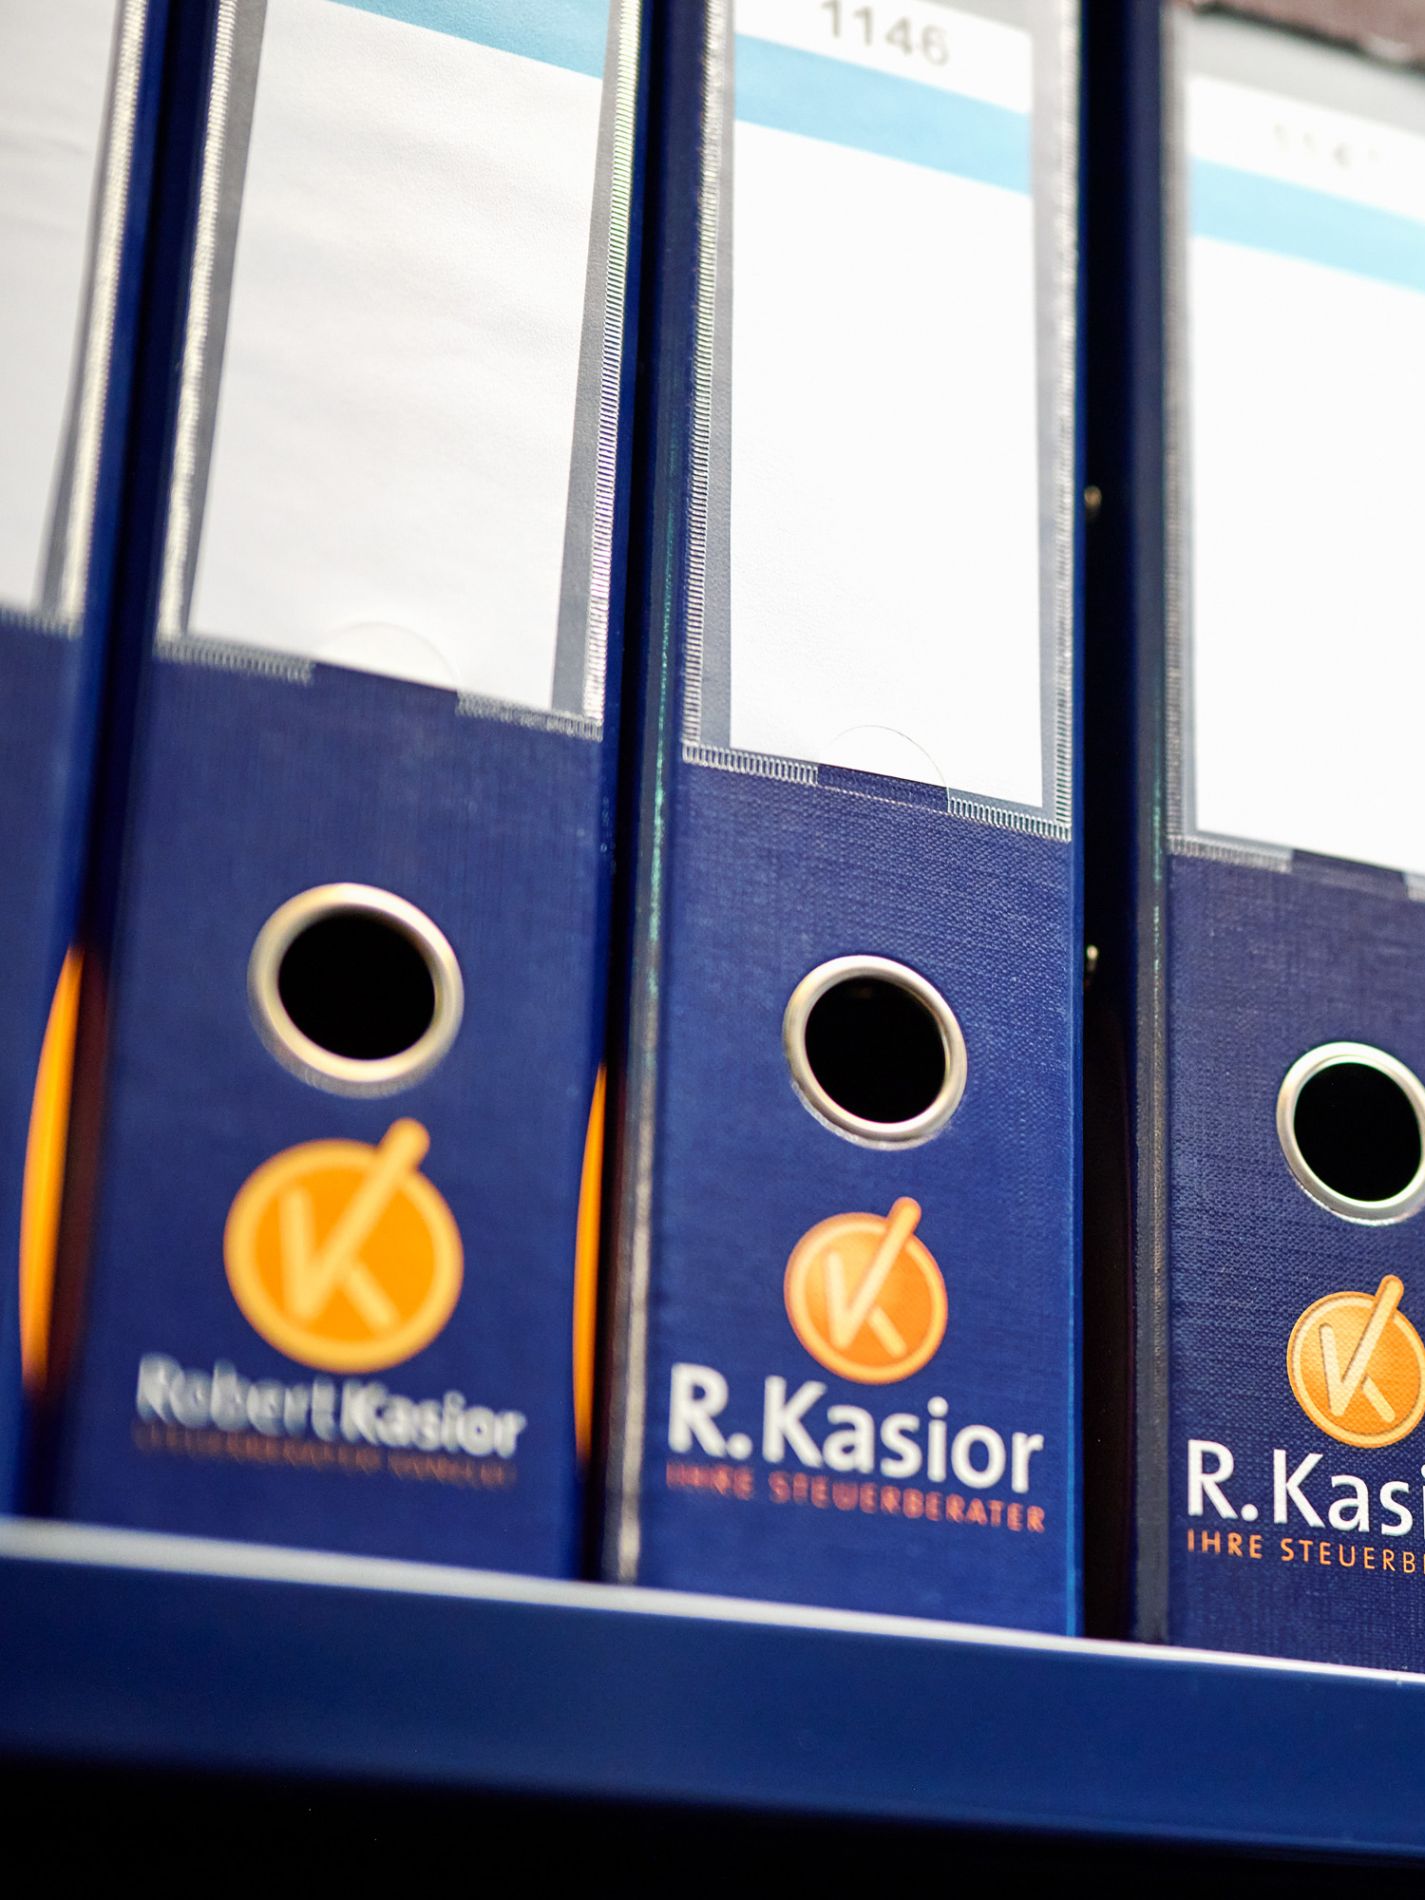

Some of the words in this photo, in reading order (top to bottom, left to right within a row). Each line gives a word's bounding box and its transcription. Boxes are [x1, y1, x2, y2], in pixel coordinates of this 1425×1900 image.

[821, 0, 950, 66] 1146
[768, 1470, 1045, 1534] STEUERBERATER
[1187, 1528, 1264, 1559] IHRE
